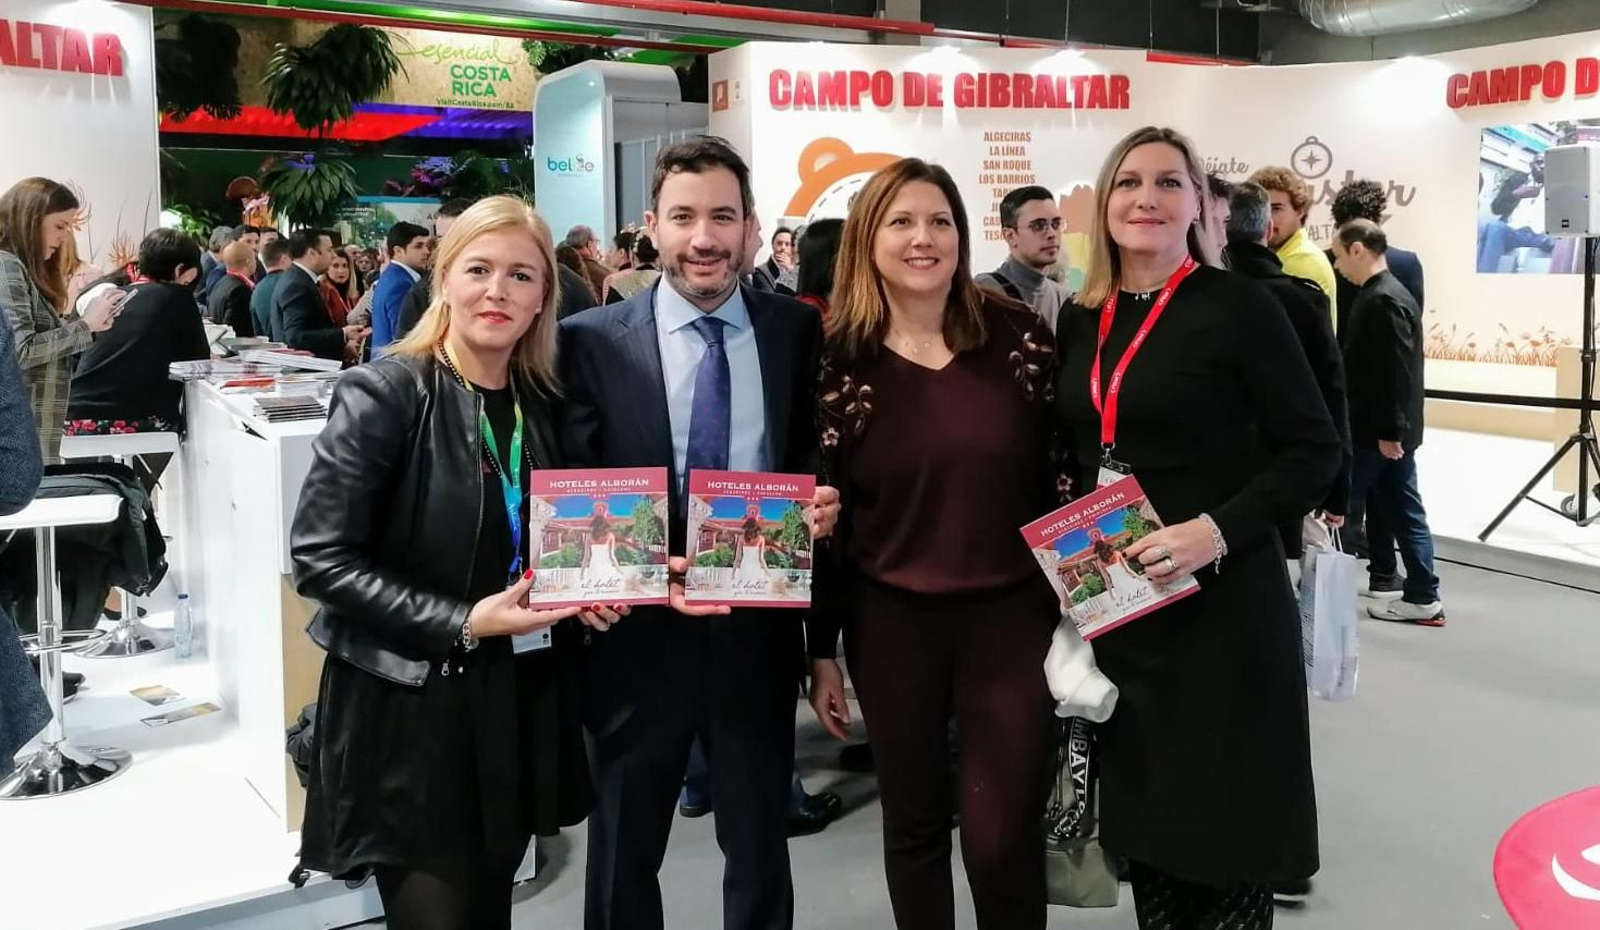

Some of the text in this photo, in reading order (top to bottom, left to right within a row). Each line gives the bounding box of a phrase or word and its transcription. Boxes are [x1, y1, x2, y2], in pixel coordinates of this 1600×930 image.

[450, 65, 511, 81] COSTA
[452, 82, 497, 97] RICA
[769, 69, 1131, 109] CAMPO DE GIBRALTAR
[1446, 57, 1600, 109] CAMPO D
[984, 131, 1031, 142] ALGECIRAS
[989, 143, 1026, 156] LA LÍNEA
[983, 160, 1031, 171] SAN ROQUE
[979, 174, 1036, 184] LOS BARRIOS
[549, 480, 598, 489] HOTELES
[600, 478, 649, 488] ALBORÁN
[707, 481, 799, 492] HOTELES ALBORÁN
[1040, 513, 1081, 537] HOTELES
[1083, 491, 1125, 516] ALBORÁN
